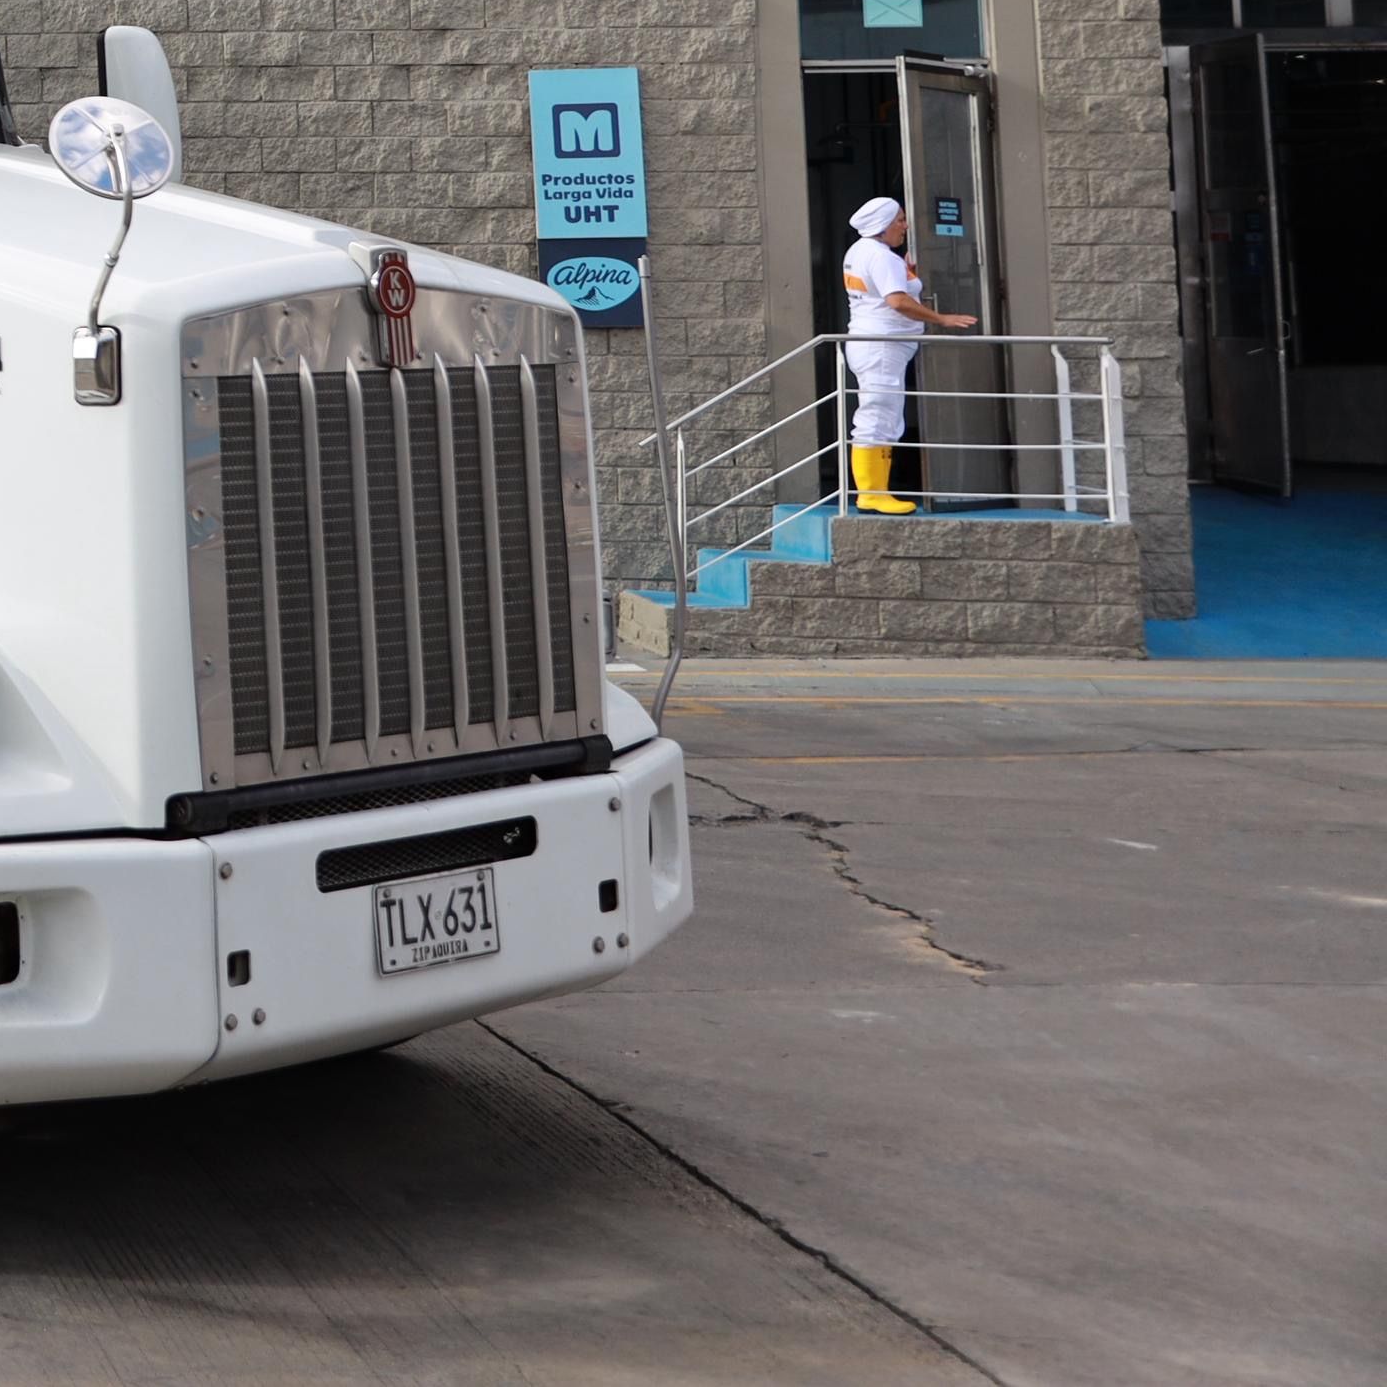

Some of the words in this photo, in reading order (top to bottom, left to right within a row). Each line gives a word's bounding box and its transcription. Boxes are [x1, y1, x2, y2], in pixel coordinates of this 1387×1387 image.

[541, 173, 635, 186] Productos
[544, 188, 589, 202] Larga
[595, 187, 634, 199] Vida
[564, 205, 619, 223] UHT
[553, 262, 632, 289] alpina
[380, 892, 435, 947] TLX
[443, 882, 492, 936] 631
[411, 939, 468, 963] ZIPAQUIRA
